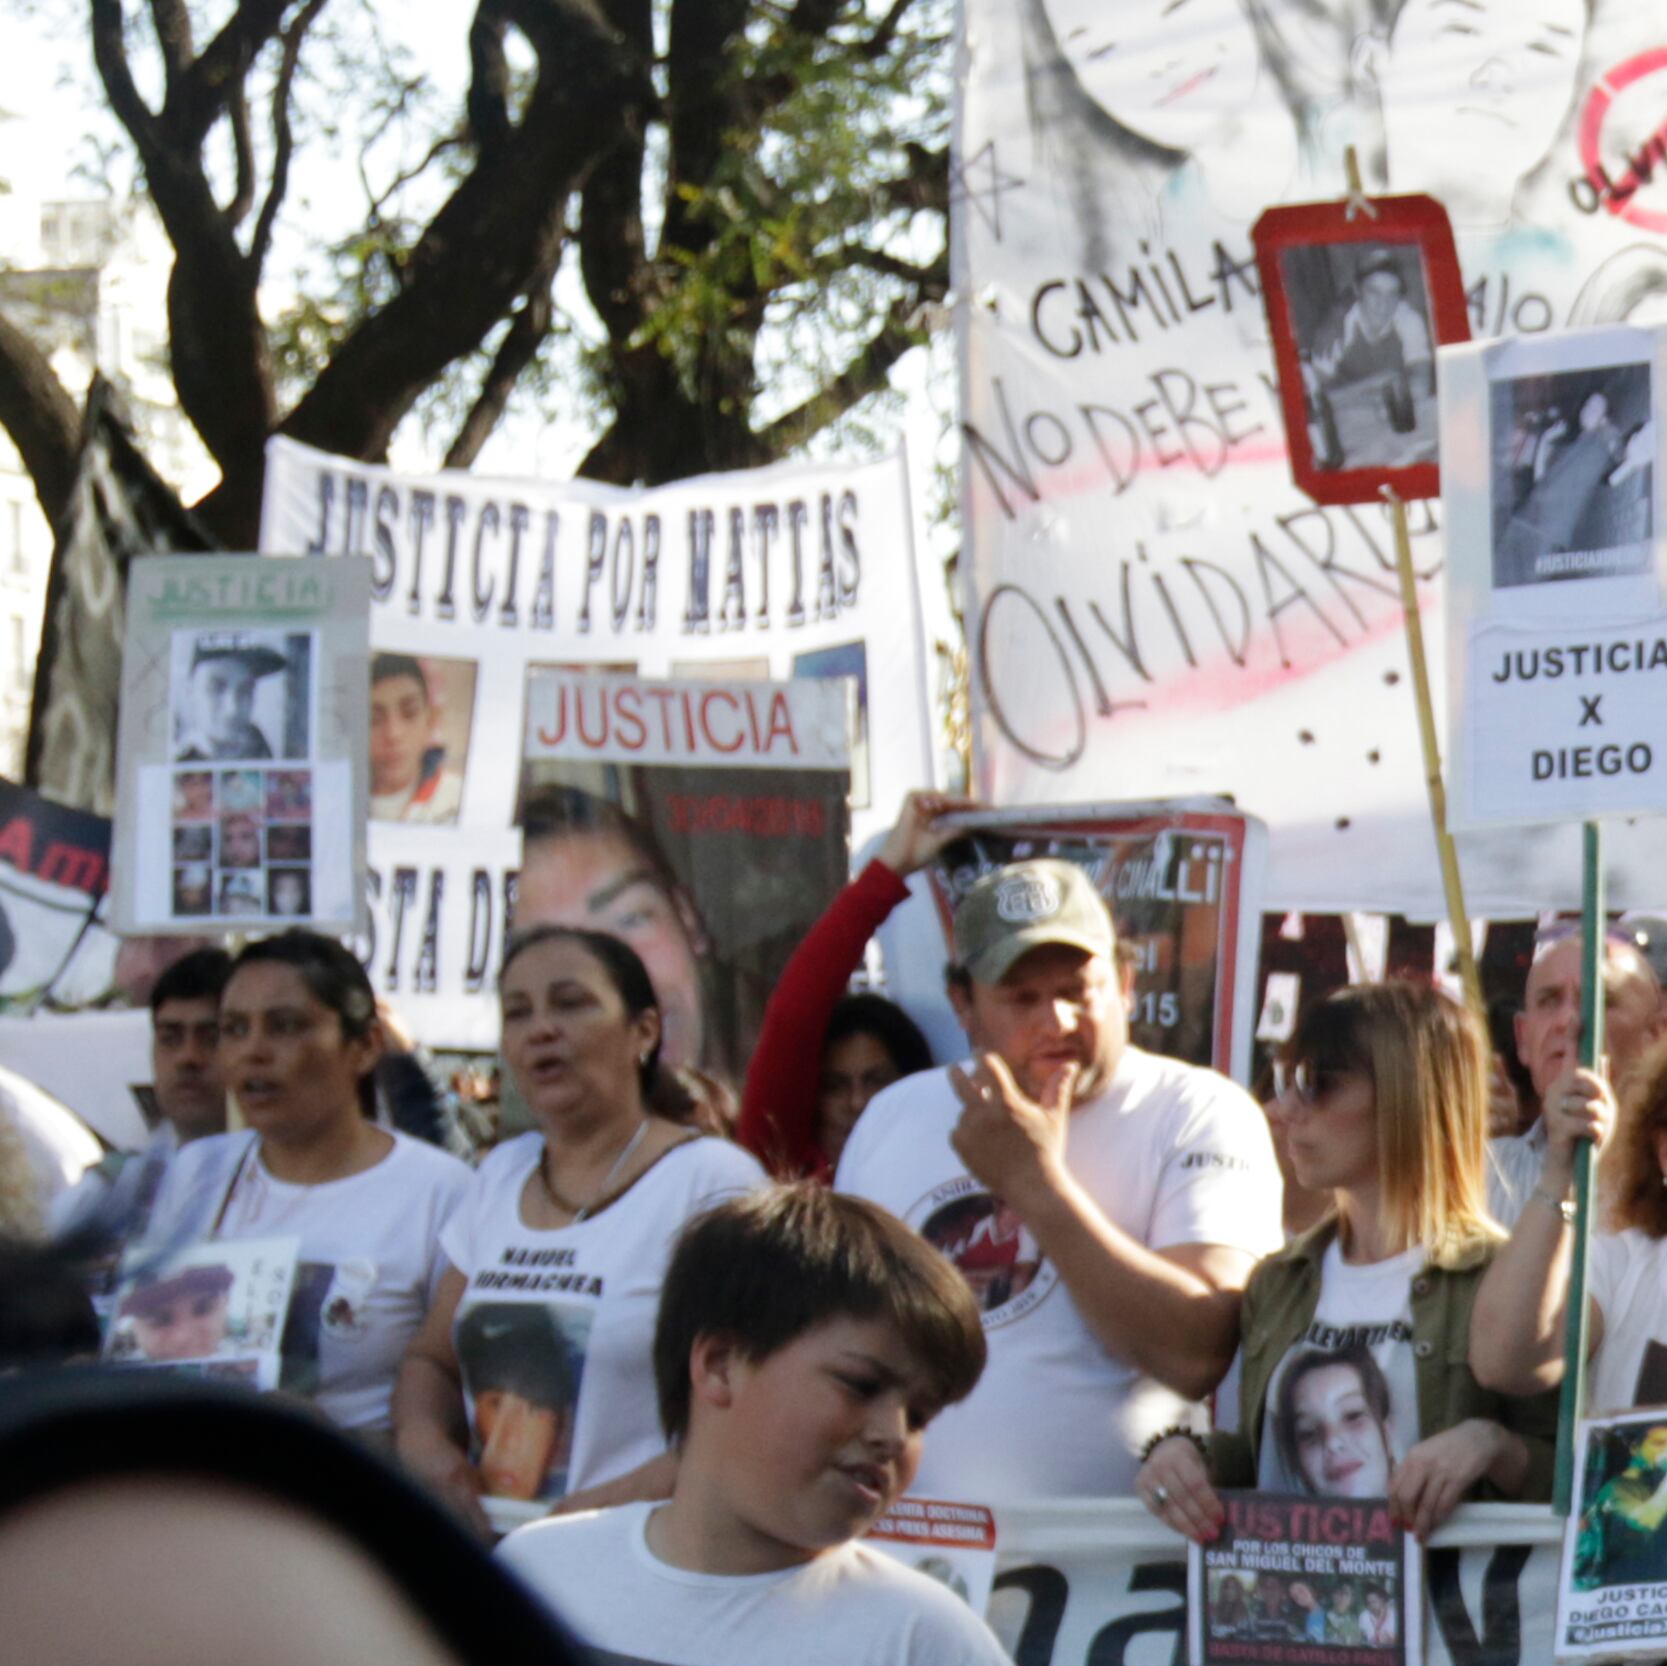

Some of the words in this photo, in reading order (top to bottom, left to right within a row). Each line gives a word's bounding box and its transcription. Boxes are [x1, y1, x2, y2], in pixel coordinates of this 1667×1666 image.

[961, 376, 1073, 521] NO
[1080, 366, 1265, 497] DEBE
[309, 473, 562, 630] JUSTICIA
[578, 507, 661, 635] POR
[682, 487, 862, 636] MATIAS
[538, 684, 800, 754] JUSTICIA
[1577, 693, 1604, 728] X
[1531, 741, 1653, 782] DIEGO
[1227, 1501, 1395, 1547] USTICIA
[1205, 1551, 1237, 1568] SAN
[1241, 1554, 1300, 1573] MIGUEL
[1304, 1557, 1335, 1574] DEL
[1339, 1559, 1397, 1578] MONTE
[1232, 1538, 1261, 1554] POR
[1263, 1541, 1290, 1556] LOS
[1292, 1543, 1343, 1560] CHICOS
[1347, 1546, 1366, 1561] DE
[1568, 1605, 1629, 1624] DIEGO
